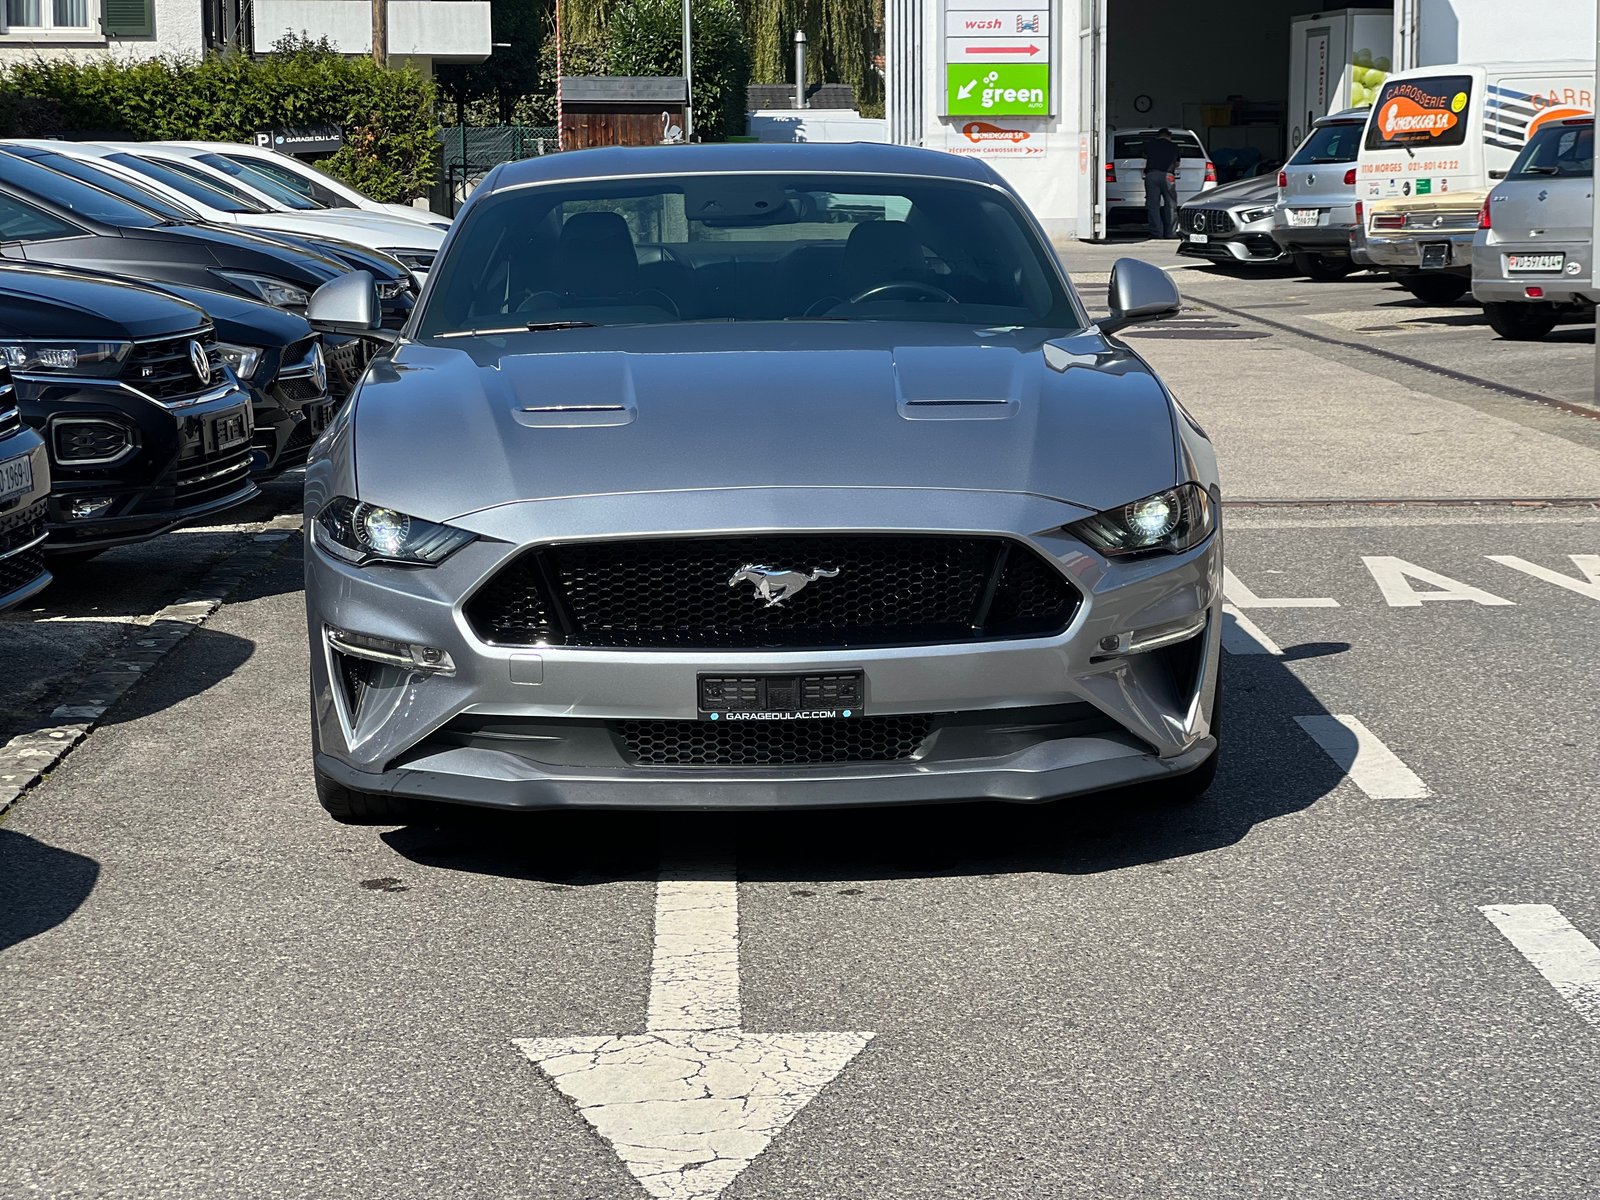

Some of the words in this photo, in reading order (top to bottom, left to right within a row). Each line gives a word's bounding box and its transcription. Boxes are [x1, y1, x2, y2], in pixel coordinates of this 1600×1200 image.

[965, 18, 1002, 29] wash
[982, 86, 1043, 108] green
[1386, 84, 1447, 108] CARROSSERIE
[1530, 88, 1591, 111] CARR
[257, 134, 269, 146] P
[1375, 163, 1402, 173] MORGES
[726, 710, 836, 720] GARAGEDULAC.COM
